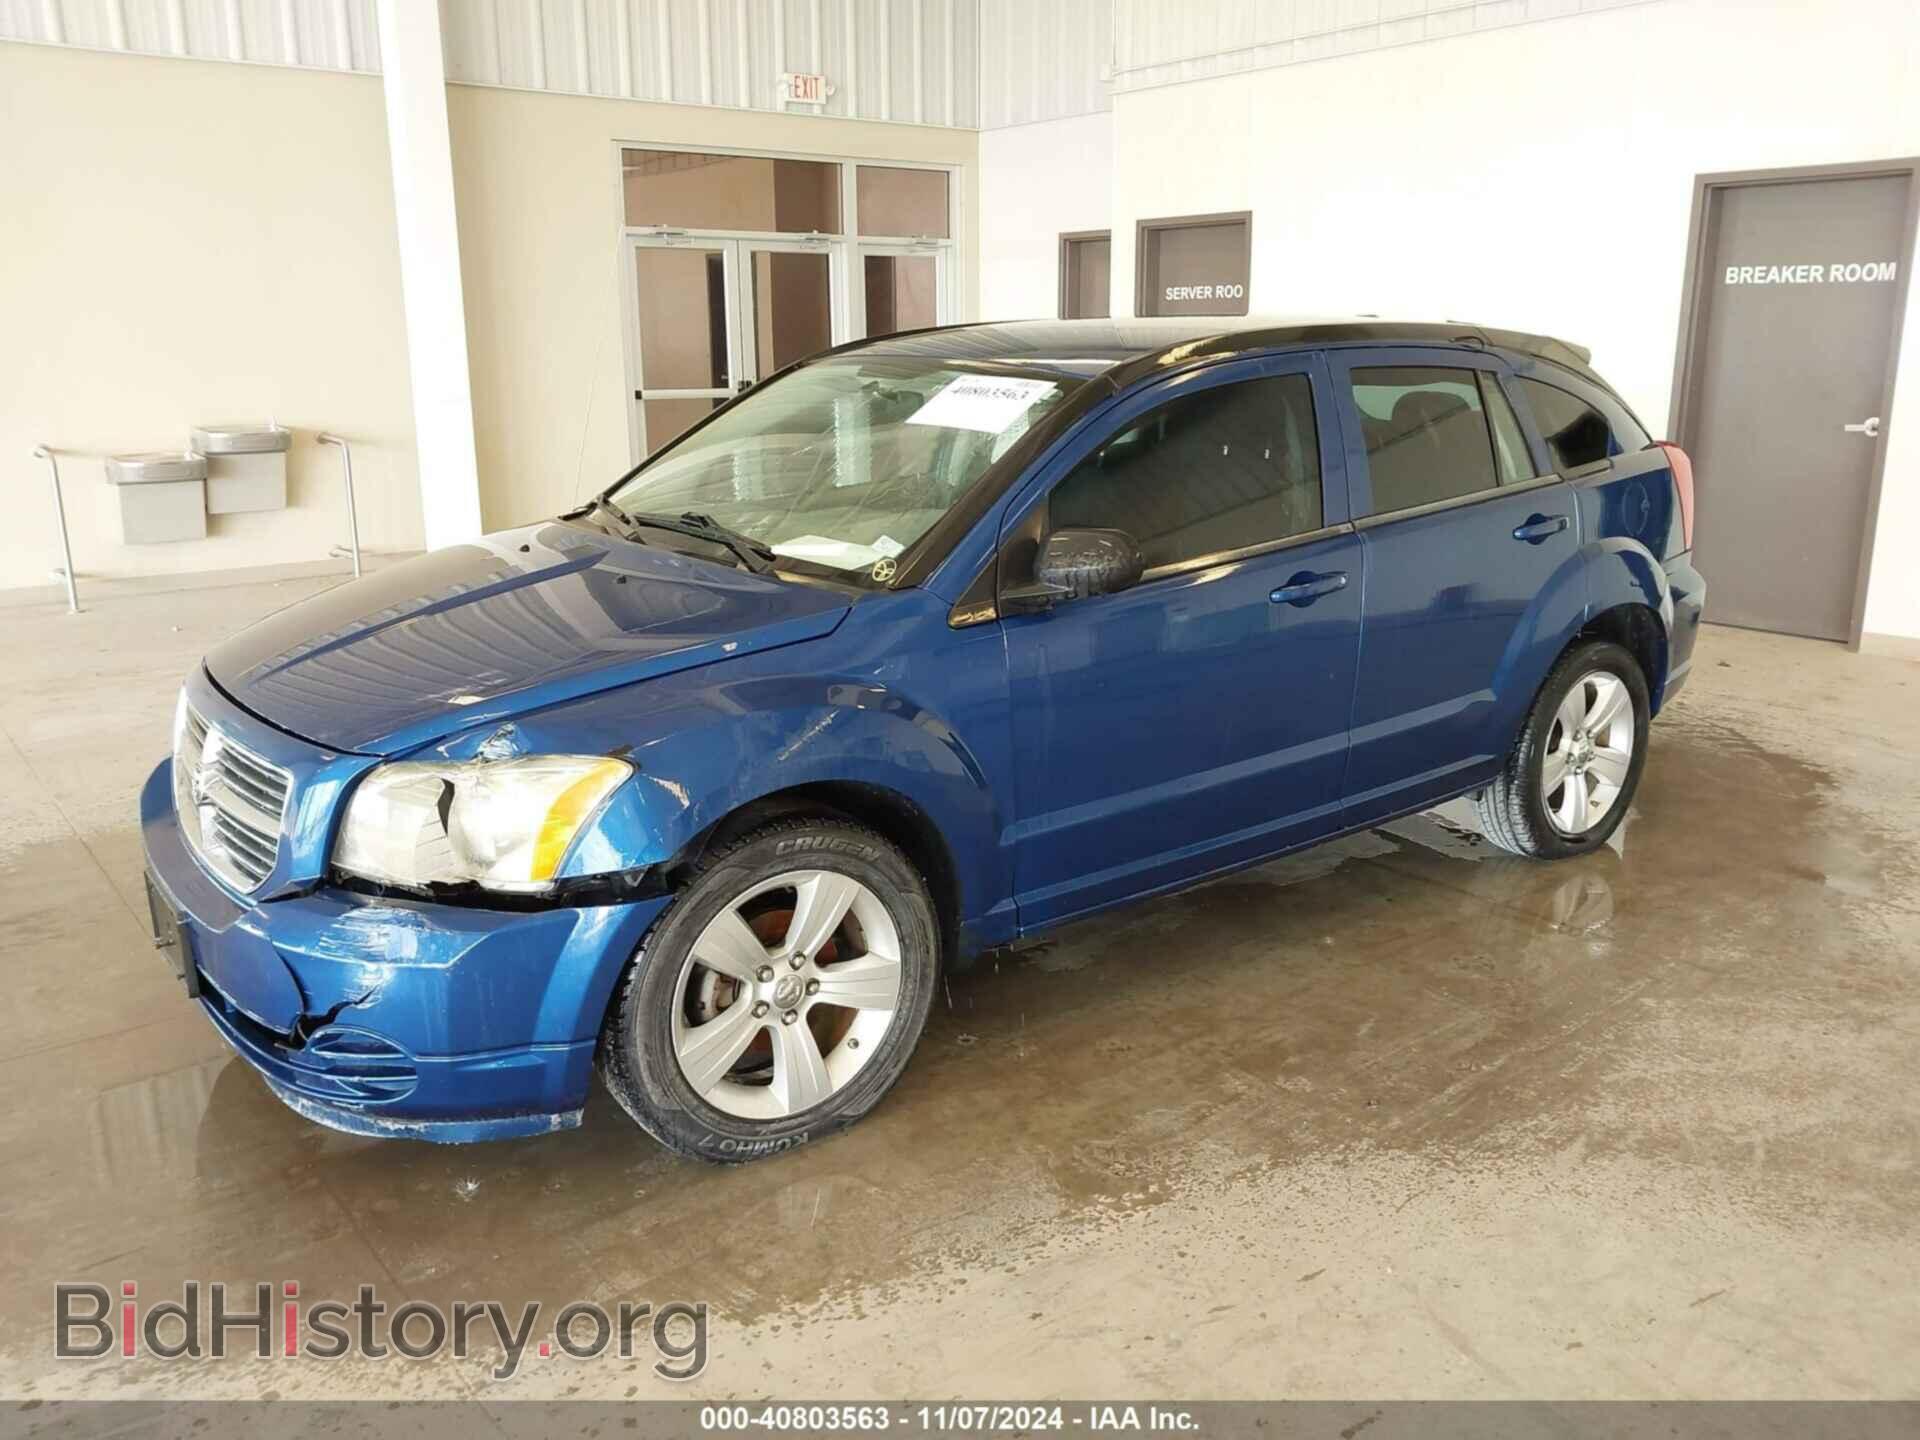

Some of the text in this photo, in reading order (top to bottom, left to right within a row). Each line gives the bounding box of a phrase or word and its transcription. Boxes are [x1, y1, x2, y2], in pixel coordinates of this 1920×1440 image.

[794, 75, 819, 100] EXIT
[1725, 262, 1896, 285] BREAKER ROOM
[1165, 284, 1244, 301] SERVER ROO
[777, 836, 881, 861] CRUGEN
[719, 1133, 809, 1156] KUMHO
